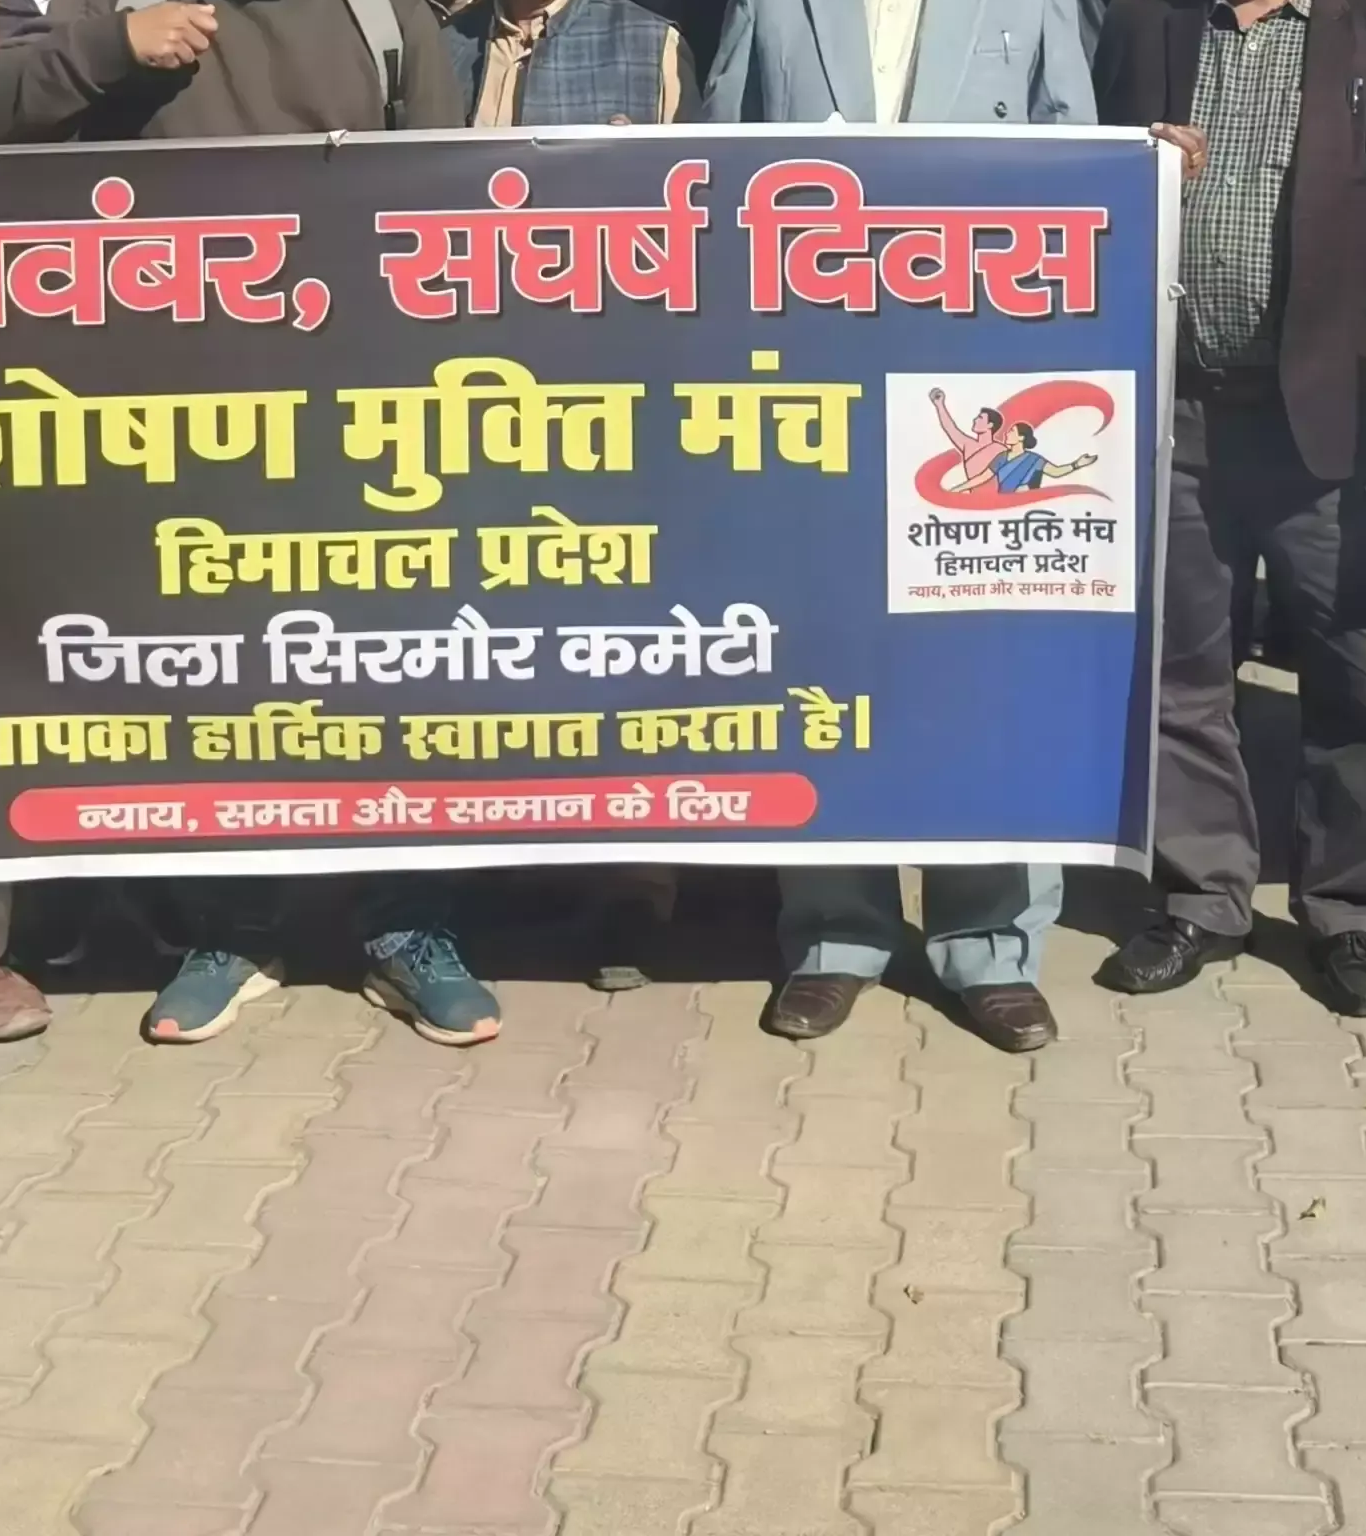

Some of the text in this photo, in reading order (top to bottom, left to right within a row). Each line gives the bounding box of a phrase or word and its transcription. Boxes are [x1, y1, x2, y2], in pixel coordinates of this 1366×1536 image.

[376, 158, 711, 320] संघर्ष
[737, 158, 1109, 317] दिवस
[336, 356, 645, 512] मुक्ति
[674, 350, 861, 473] मंच
[155, 506, 658, 596] हिमाचल प्रदेश
[907, 510, 1117, 551] शोषण मुक्ति मंच
[935, 548, 1089, 577] हिमाचल प्रदेश
[949, 582, 986, 598] समता
[1018, 580, 1065, 596] सम्मान
[1070, 579, 1086, 596] के
[1091, 579, 1117, 597] लिए
[39, 602, 779, 687] जिला सिरमौर कमेटी
[187, 699, 384, 761] हार्दिक
[399, 711, 605, 760] स्वागत
[617, 703, 784, 752] करता
[78, 780, 751, 832] न्याय, समता और सम्मान के लिए
